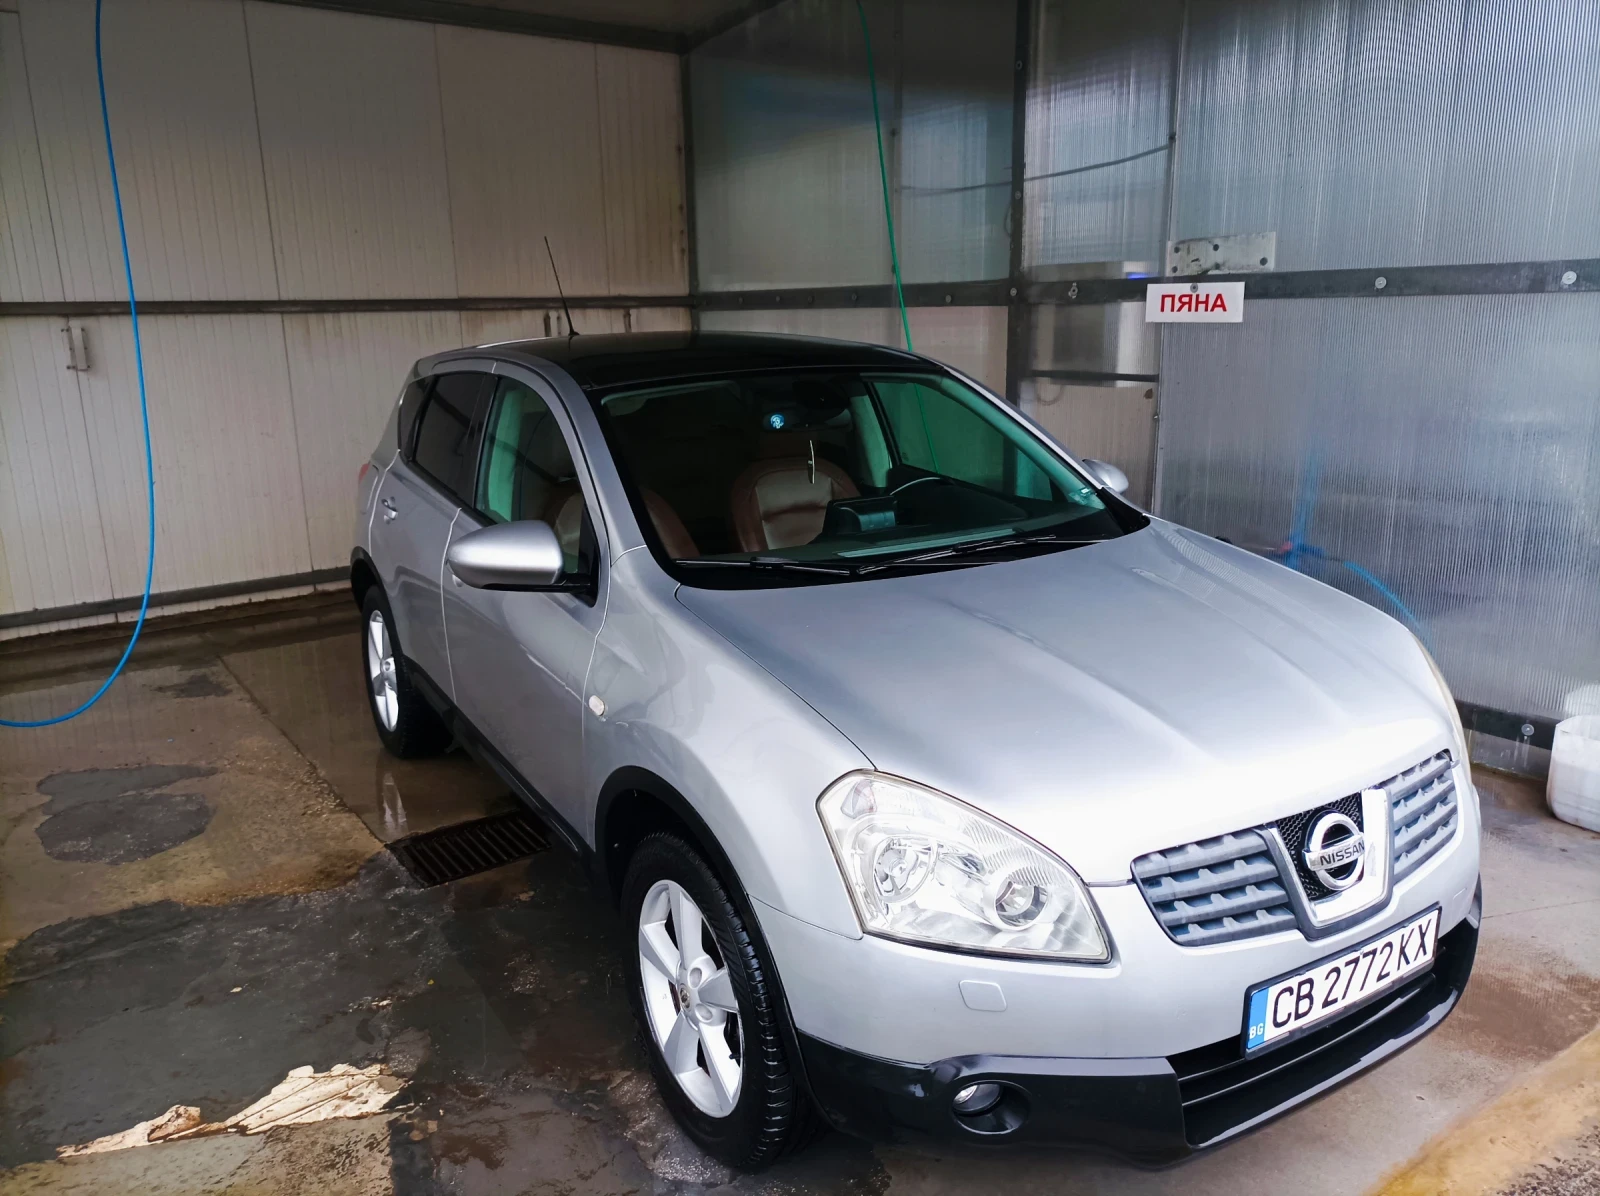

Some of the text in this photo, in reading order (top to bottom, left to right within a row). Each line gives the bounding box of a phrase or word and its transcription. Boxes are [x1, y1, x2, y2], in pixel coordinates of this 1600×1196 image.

[1160, 293, 1228, 312] ПЯНА
[1319, 839, 1365, 866] NISSAN
[1272, 918, 1432, 1028] CB 2772 KX
[1249, 1023, 1264, 1038] BG
